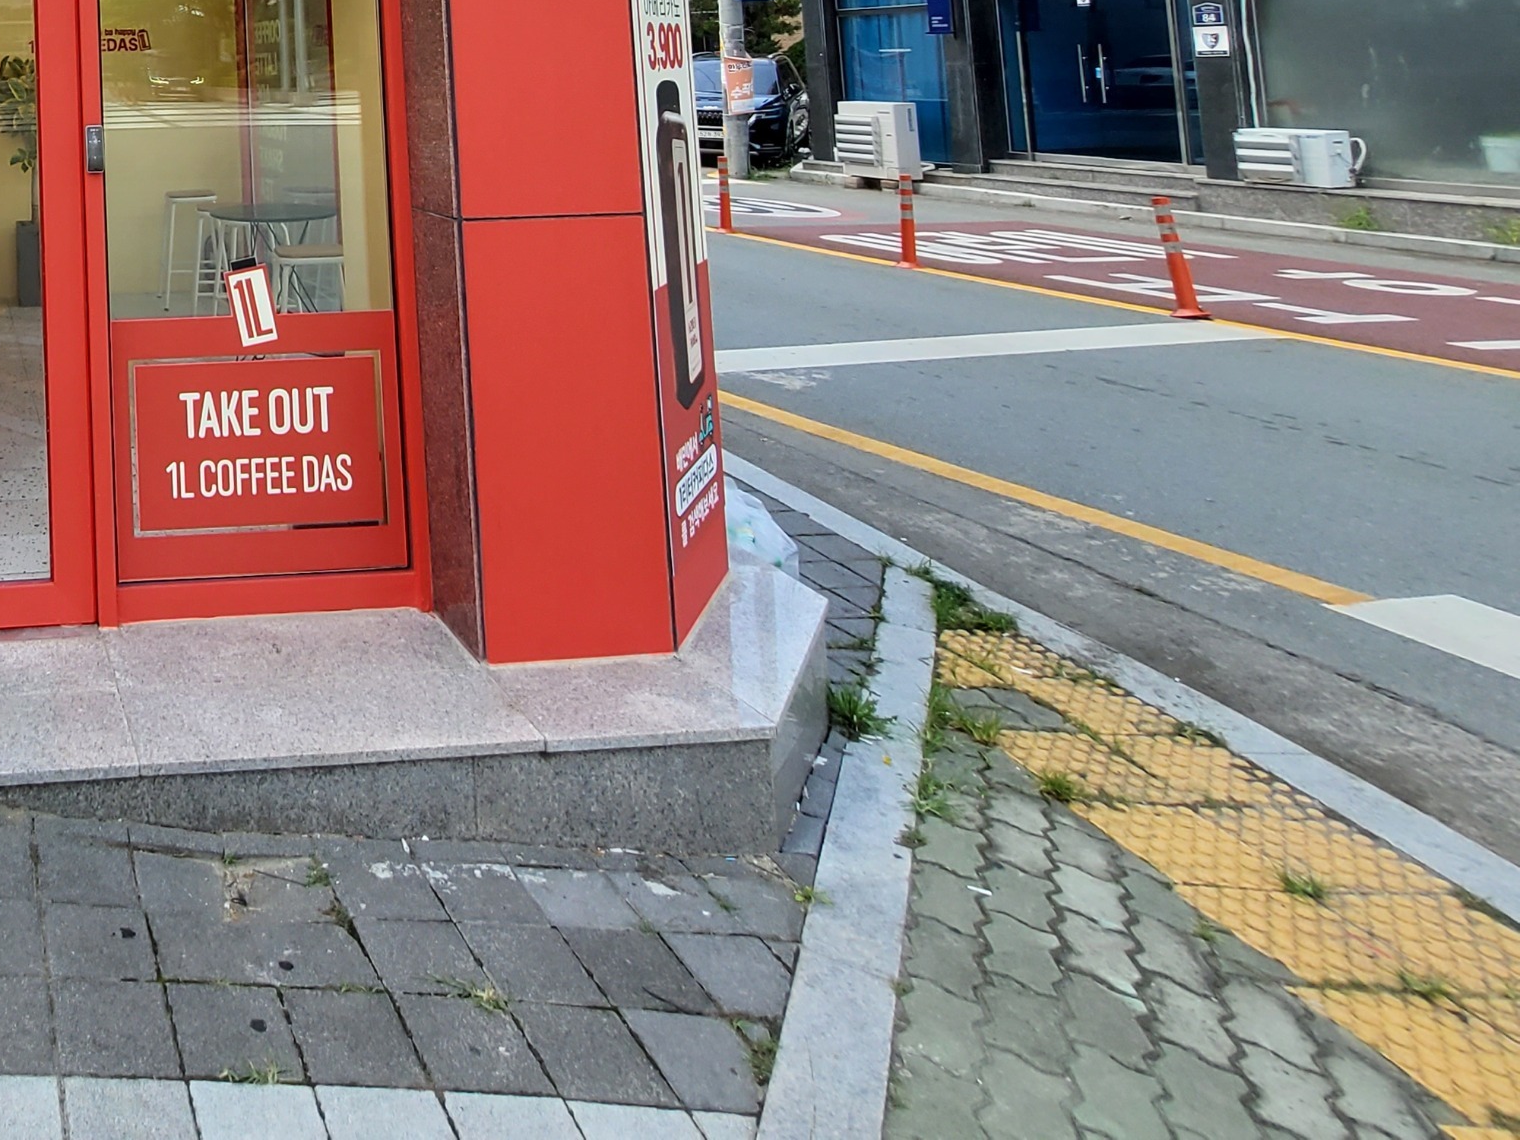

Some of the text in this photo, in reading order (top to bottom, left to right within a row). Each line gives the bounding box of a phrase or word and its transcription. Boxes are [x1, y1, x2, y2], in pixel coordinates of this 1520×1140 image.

[646, 22, 683, 72] 3,900
[179, 386, 335, 440] TAKE OUT
[165, 453, 354, 500] 1L COFFEE DAS
